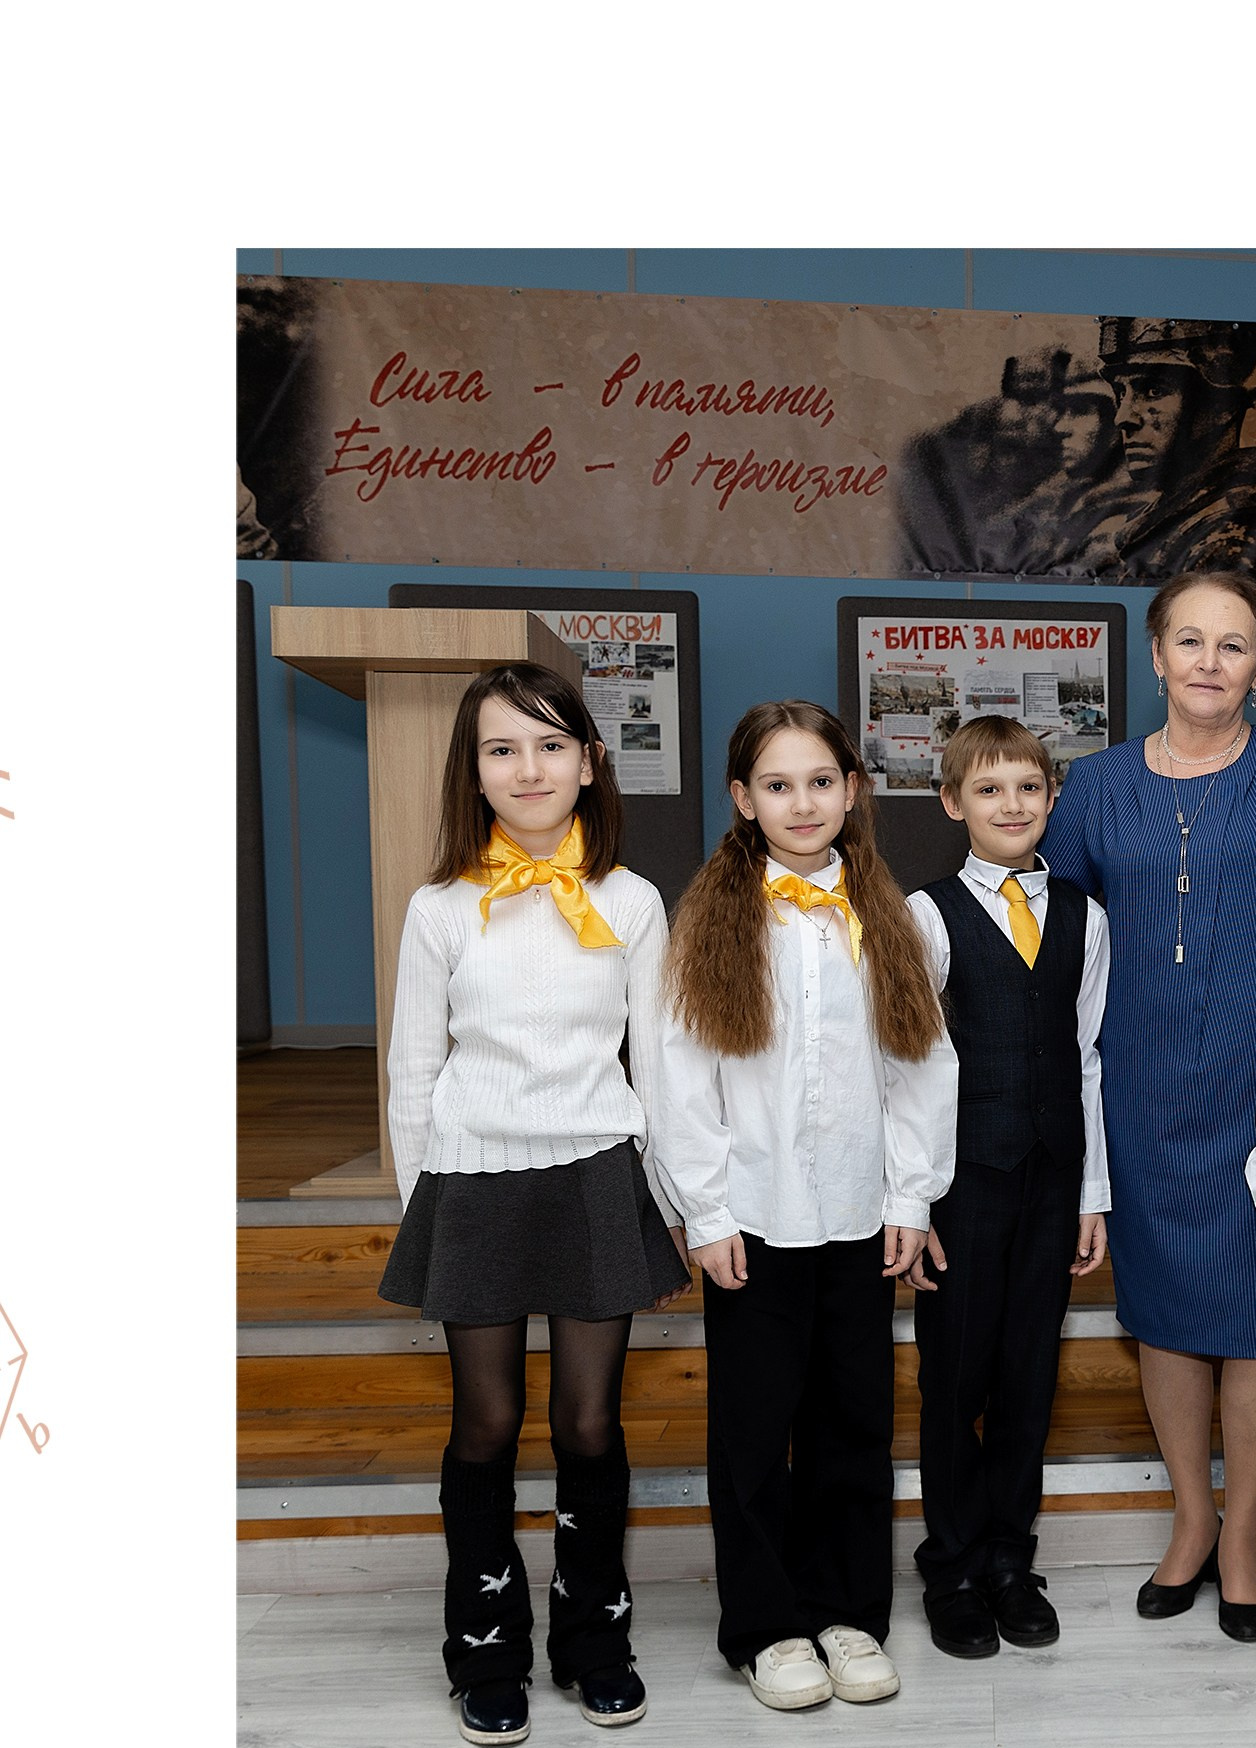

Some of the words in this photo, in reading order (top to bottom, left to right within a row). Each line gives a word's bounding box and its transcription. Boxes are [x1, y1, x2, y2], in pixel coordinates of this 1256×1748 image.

[369, 350, 492, 408] Сила
[326, 418, 557, 503] Единство
[652, 431, 691, 487] в
[691, 449, 887, 513] героизме
[559, 614, 662, 643] МОСКВУ!
[884, 626, 967, 650] БИТВА
[973, 626, 1006, 650] ЗА
[1013, 627, 1102, 650] МОСКВУ
[970, 686, 993, 694] ПАМЯТЬ
